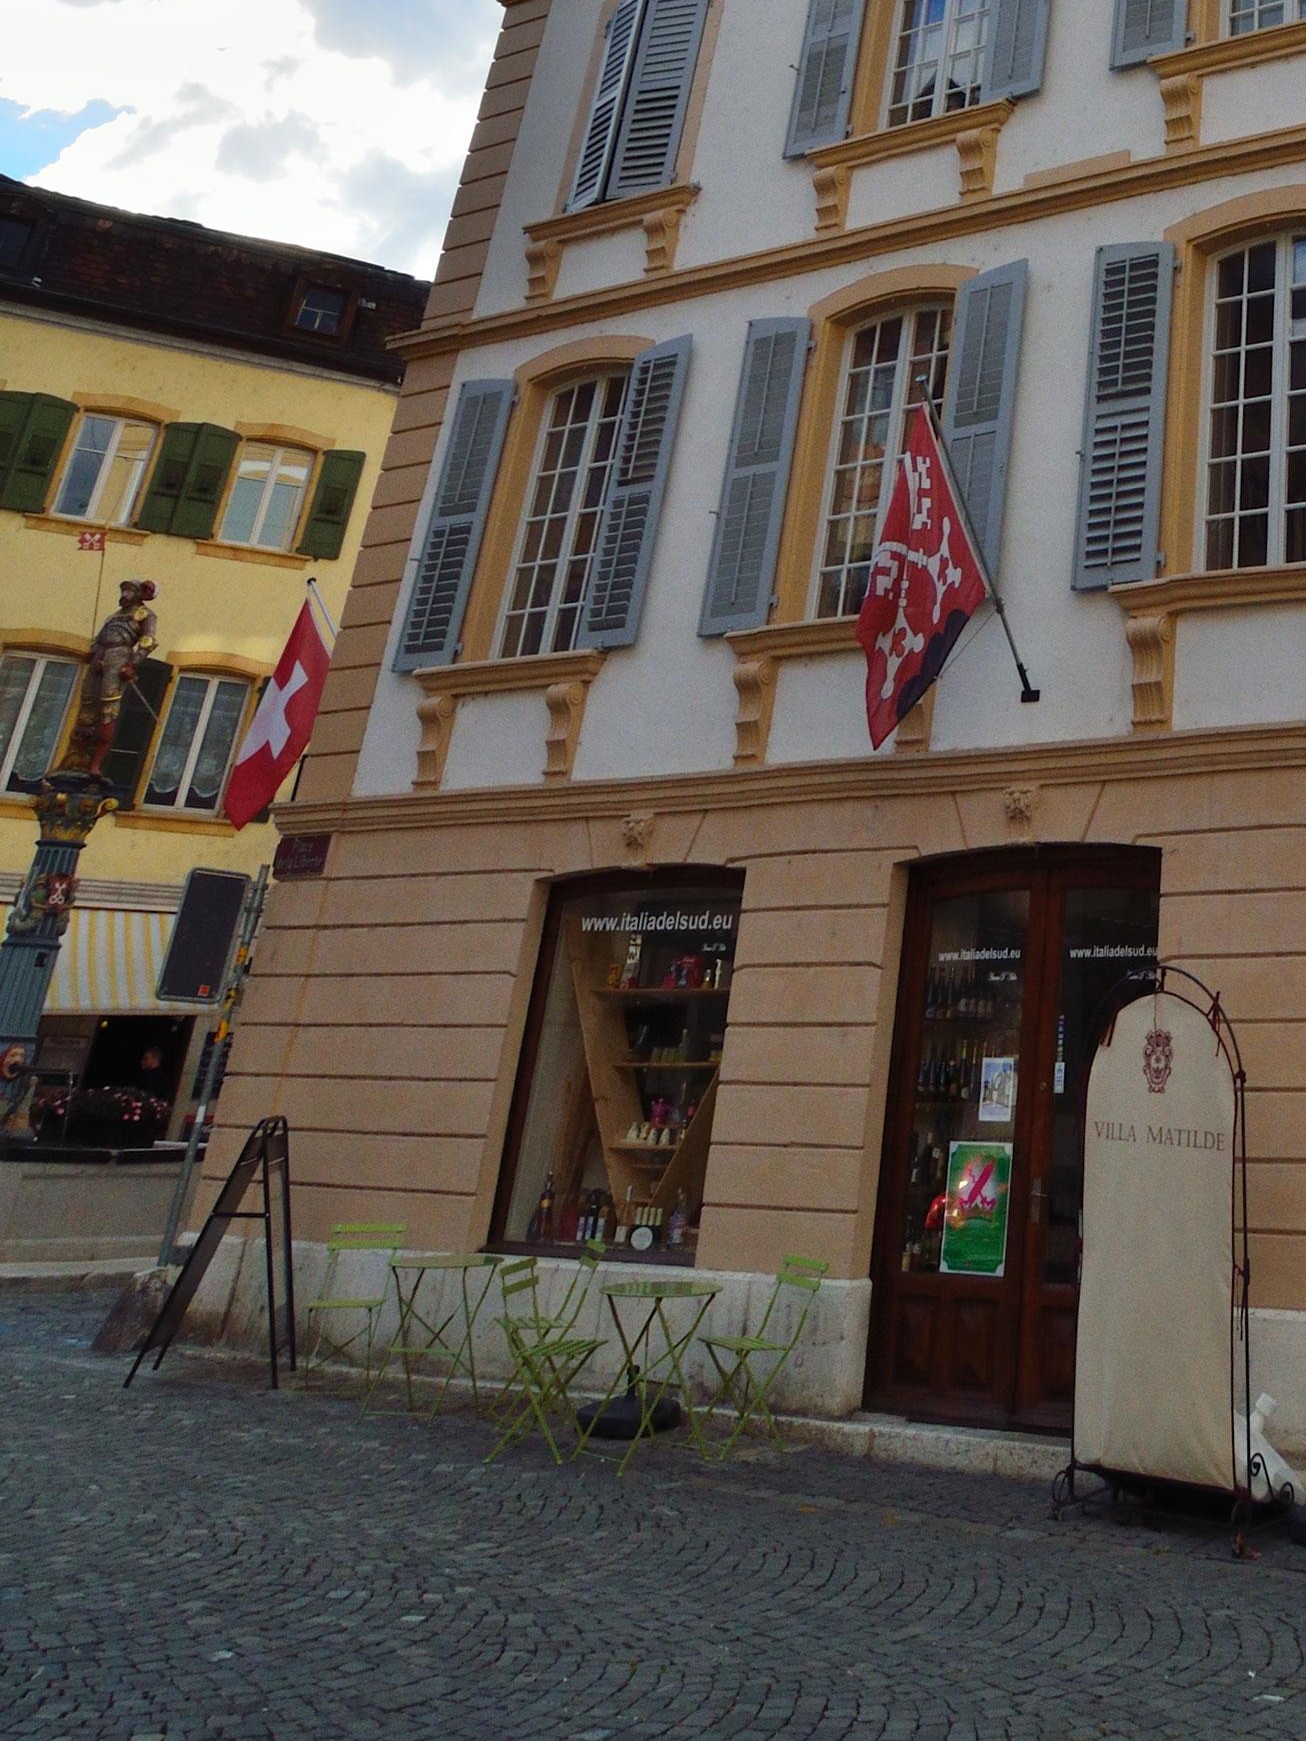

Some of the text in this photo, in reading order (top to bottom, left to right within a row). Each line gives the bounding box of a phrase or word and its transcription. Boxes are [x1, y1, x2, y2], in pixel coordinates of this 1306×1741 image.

[581, 910, 733, 932] www.italiadelsud.eu
[939, 948, 1020, 961] www.italiadelsud.eu
[1070, 944, 1158, 959] www.italiadelsud.eu
[1094, 1121, 1226, 1152] VILLA MATILDE
